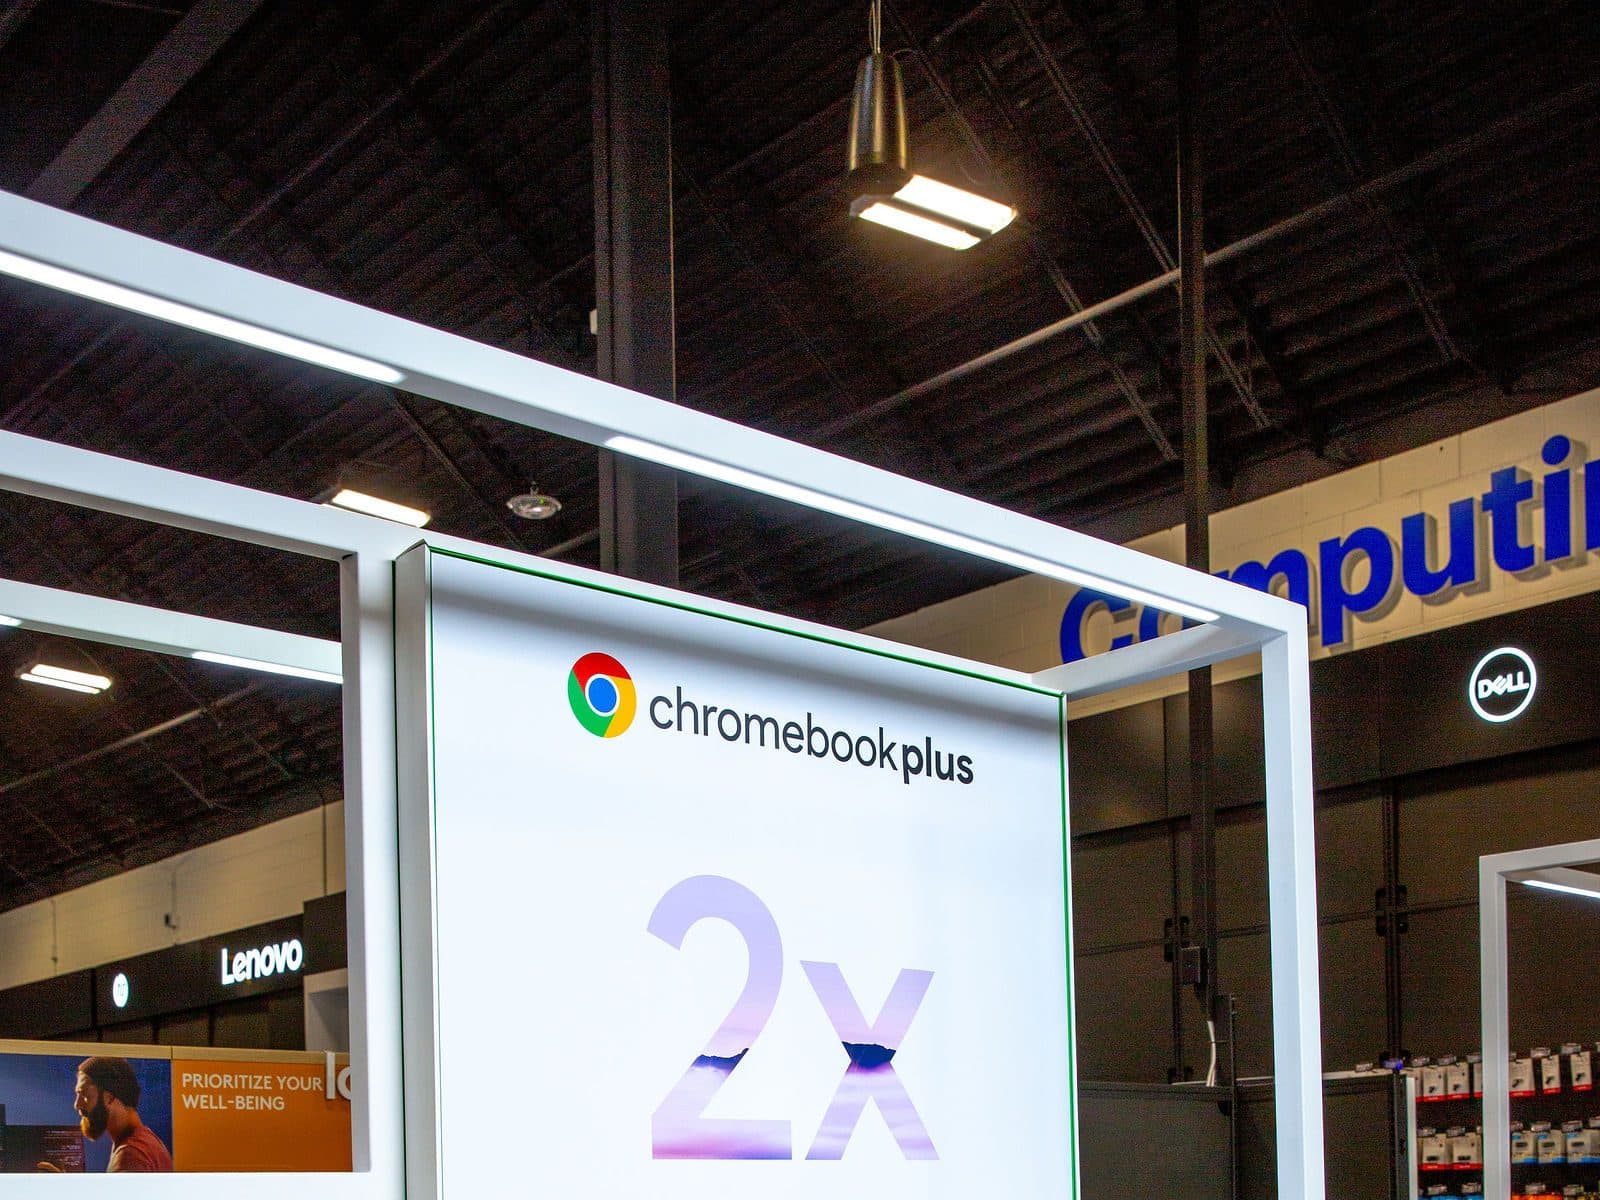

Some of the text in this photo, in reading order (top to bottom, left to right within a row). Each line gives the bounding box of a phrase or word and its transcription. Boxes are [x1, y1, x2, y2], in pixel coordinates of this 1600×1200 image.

[1060, 434, 1600, 664] cputi
[1477, 671, 1530, 699] DELL
[221, 938, 303, 986] Lenovo
[646, 874, 941, 1161] 2x
[182, 1072, 323, 1092] PRIORITIZE YOUR
[182, 1093, 285, 1111] WELL-BEING
